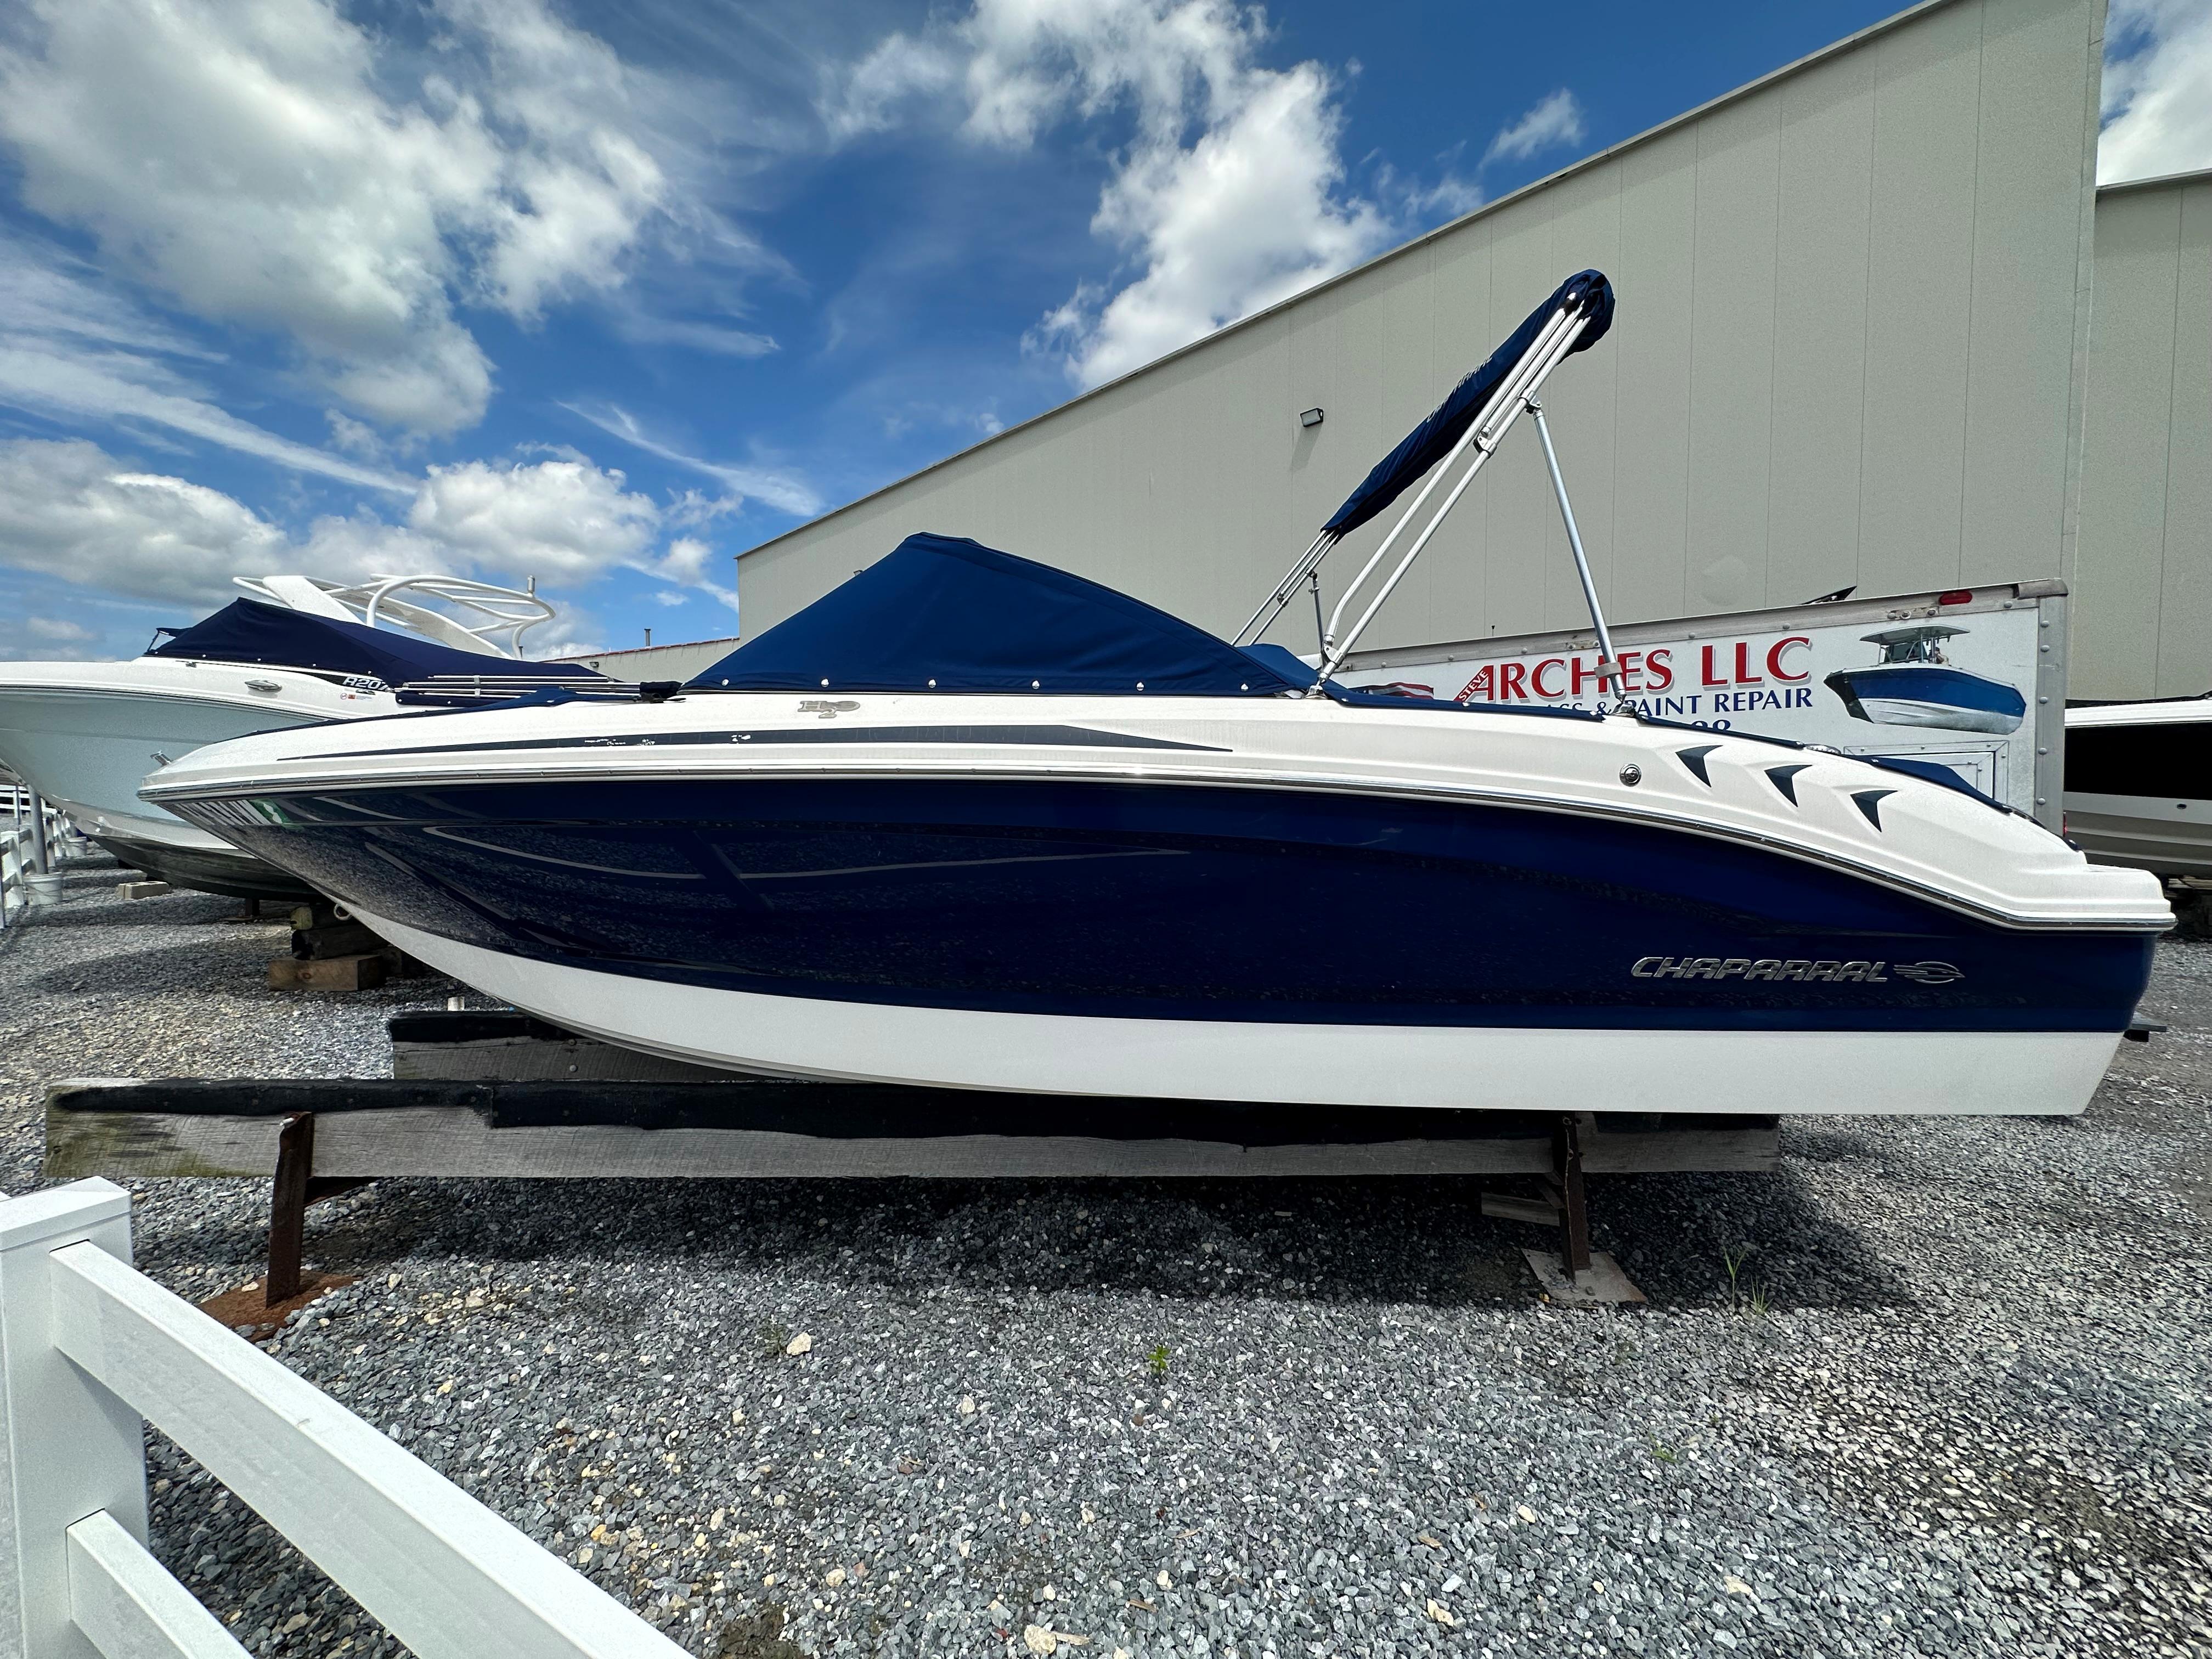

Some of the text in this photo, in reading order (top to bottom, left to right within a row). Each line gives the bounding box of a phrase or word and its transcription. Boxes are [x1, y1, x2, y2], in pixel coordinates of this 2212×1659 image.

[1453, 636, 1810, 702] ARCHES LLC
[1458, 670, 1488, 701] STEVE
[1714, 687, 1813, 713] REPAIR
[1630, 957, 1888, 983] CHAPARRAL
